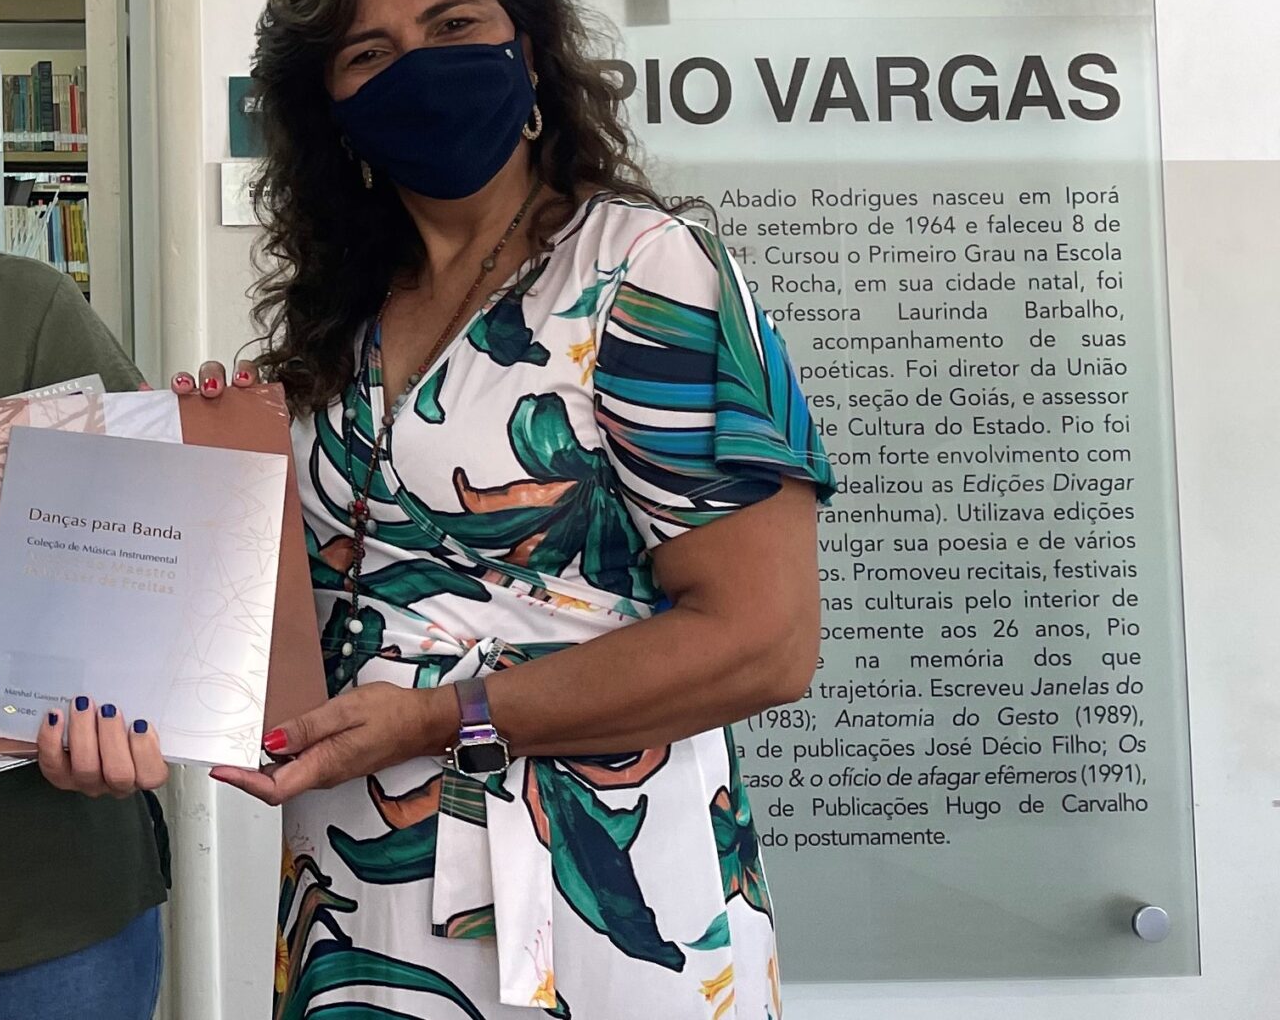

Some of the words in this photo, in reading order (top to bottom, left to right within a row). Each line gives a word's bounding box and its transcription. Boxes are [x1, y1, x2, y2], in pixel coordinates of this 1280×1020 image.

[755, 53, 1122, 124] VARGAS
[719, 188, 798, 208] Abadio
[811, 187, 919, 212] Rodrigues
[932, 192, 1004, 206] nasceu
[1018, 191, 1051, 205] em
[1065, 185, 1120, 210] Iporá
[720, 216, 748, 237] de
[757, 215, 858, 237] setembro
[867, 215, 895, 236] de
[905, 215, 957, 235] 1964
[965, 220, 978, 234] e
[986, 213, 1063, 234] faleceu
[1072, 213, 1085, 233] 8
[1093, 212, 1121, 233] de
[764, 245, 839, 265] Cursou
[847, 250, 861, 264] o
[868, 244, 957, 264] Primeiro
[964, 243, 1016, 263] Grau
[1023, 248, 1048, 262] na
[1056, 241, 1122, 262] Escola
[771, 272, 842, 296] Rocha,
[854, 279, 887, 293] em
[898, 278, 934, 292] sua
[945, 270, 1016, 292] cidade
[1028, 269, 1085, 293] natal,
[1096, 269, 1123, 290] foi
[764, 301, 862, 323] rofessora
[898, 299, 988, 321] Laurinda
[1025, 298, 1124, 322] Barbalho,
[812, 329, 1004, 355] acompanhamento
[1029, 327, 1056, 348] de
[1081, 333, 1127, 348] suas
[799, 359, 895, 385] poéticas.
[906, 359, 938, 378] Foi
[948, 357, 1020, 378] diretor
[1030, 356, 1056, 377] da
[1067, 357, 1128, 377] União
[847, 416, 925, 437] Cultura
[934, 415, 963, 436] do
[972, 414, 1051, 435] Estado.
[1061, 415, 1095, 434] Pio
[1102, 412, 1130, 434] foi
[828, 451, 871, 466] com
[877, 444, 930, 465] forte
[936, 443, 1080, 465] envolvimento
[1086, 448, 1131, 463] com
[836, 473, 923, 495] dealizou
[931, 479, 954, 494] as
[963, 472, 1045, 498] Edições
[1052, 472, 1135, 497] Divagar
[29, 507, 87, 528] Danças
[92, 520, 126, 533] para
[133, 522, 182, 540] Banda
[816, 499, 948, 526] ranenhuma).
[957, 501, 1045, 522] Utilizava
[1053, 500, 1135, 526] edições
[27, 536, 65, 550] Coleção
[68, 542, 80, 552] de
[83, 545, 116, 557] Música
[120, 549, 178, 565] Instrumental
[819, 532, 885, 558] vulgar
[893, 538, 929, 552] sua
[938, 531, 1008, 557] poesia
[1016, 536, 1029, 551] e
[1038, 529, 1066, 550] de
[1073, 529, 1136, 550] vários
[820, 622, 924, 641] ocemente
[940, 625, 977, 639] aos
[992, 618, 1019, 638] 26
[1035, 623, 1090, 640] anos,
[1107, 617, 1140, 637] Pio
[855, 655, 880, 669] na
[910, 647, 1004, 669] memória
[1033, 646, 1072, 667] dos
[1101, 651, 1142, 672] que
[818, 678, 923, 705] trajetória.
[930, 678, 1024, 698] Escreveu
[1030, 675, 1110, 697] Janelas
[1115, 674, 1144, 695] do
[747, 705, 817, 733] (1983);
[834, 707, 935, 728] Anatomia
[952, 705, 980, 727] do
[997, 706, 1059, 726] Gesto
[1075, 704, 1144, 729] (1989),
[756, 737, 783, 759] de
[793, 737, 916, 764] publicações
[924, 736, 972, 757] José
[982, 735, 1042, 756] Décio
[1052, 733, 1107, 757] Filho;
[1118, 733, 1147, 754] Os
[788, 767, 805, 788] &
[809, 773, 824, 788] o
[828, 766, 882, 787] ofício
[886, 765, 913, 787] de
[917, 765, 981, 792] afagar
[984, 764, 1077, 785] efêmeros
[1081, 763, 1147, 787] (1991),
[767, 796, 795, 818] de
[812, 795, 929, 821] Publicações
[945, 795, 1002, 821] Hugo
[1018, 793, 1045, 814] de
[1061, 791, 1149, 813] Carvalho
[794, 827, 951, 853] postumamente.
